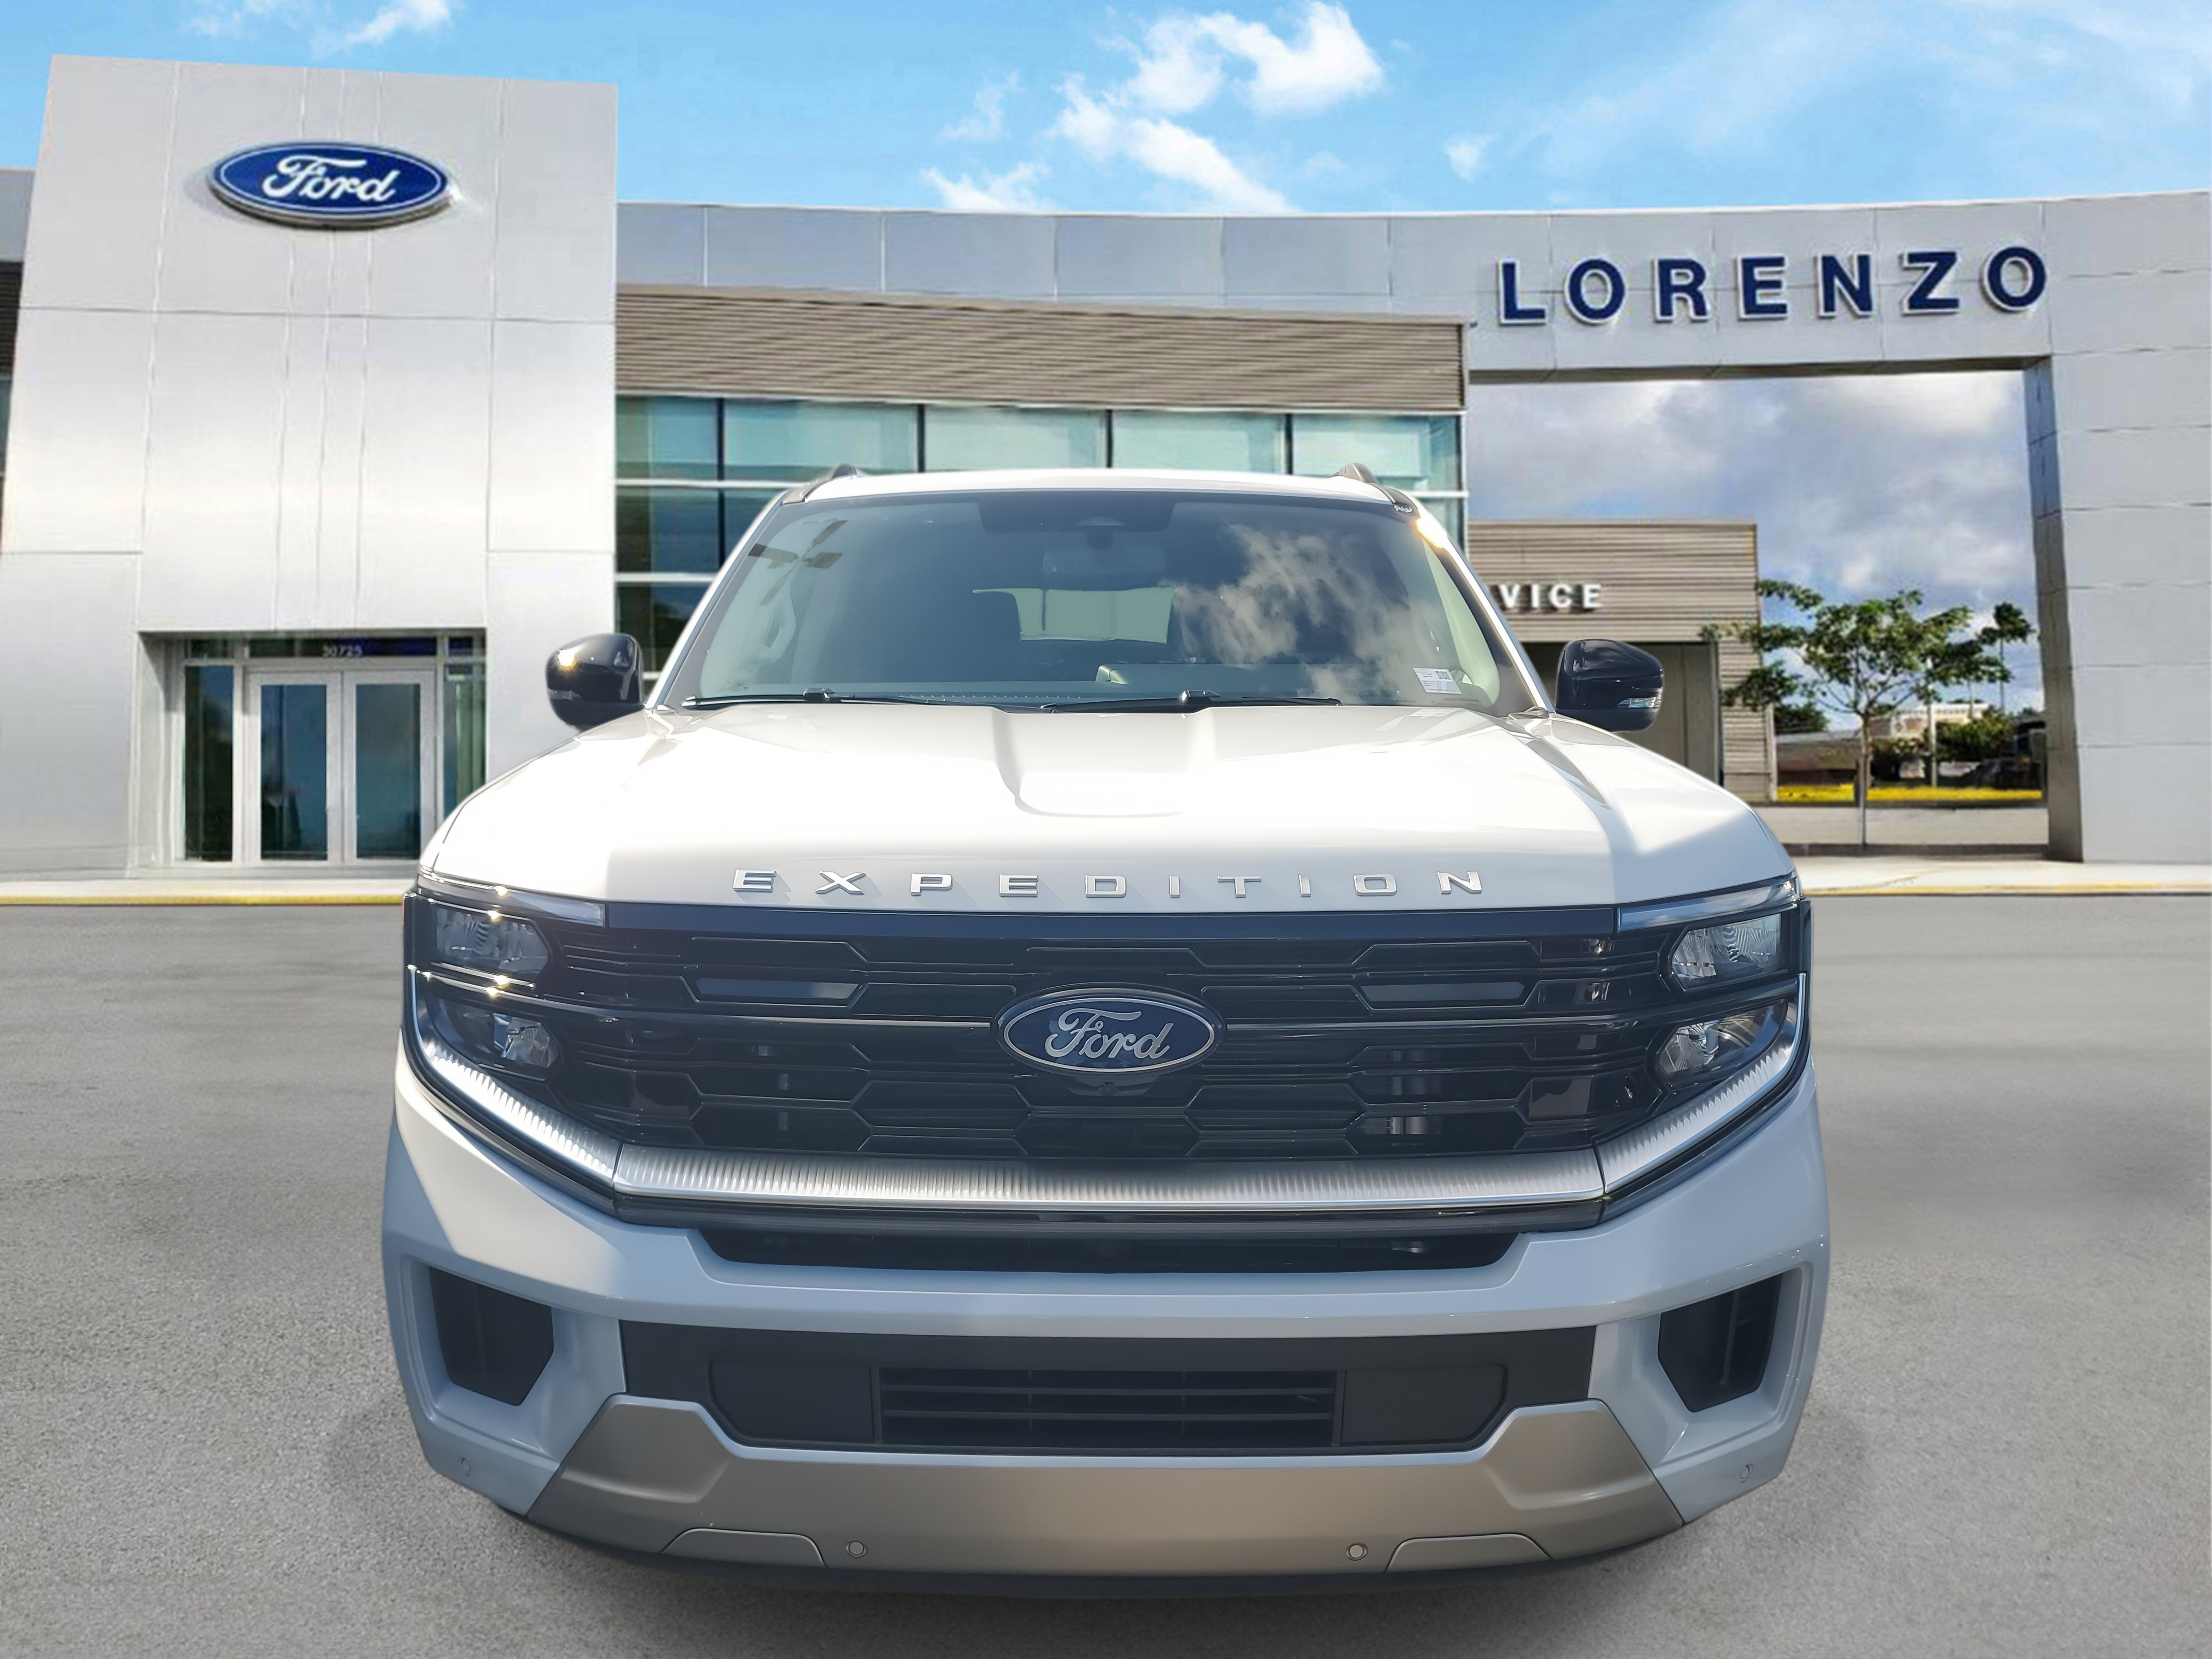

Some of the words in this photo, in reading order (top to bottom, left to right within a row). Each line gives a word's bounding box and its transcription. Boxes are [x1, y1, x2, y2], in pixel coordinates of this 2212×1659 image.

[262, 154, 401, 202] Ford
[1496, 246, 2047, 325] LORENZO
[1499, 583, 1602, 609] VICE
[732, 869, 1483, 898] EXPEDITION
[1044, 1007, 1174, 1059] Ford
